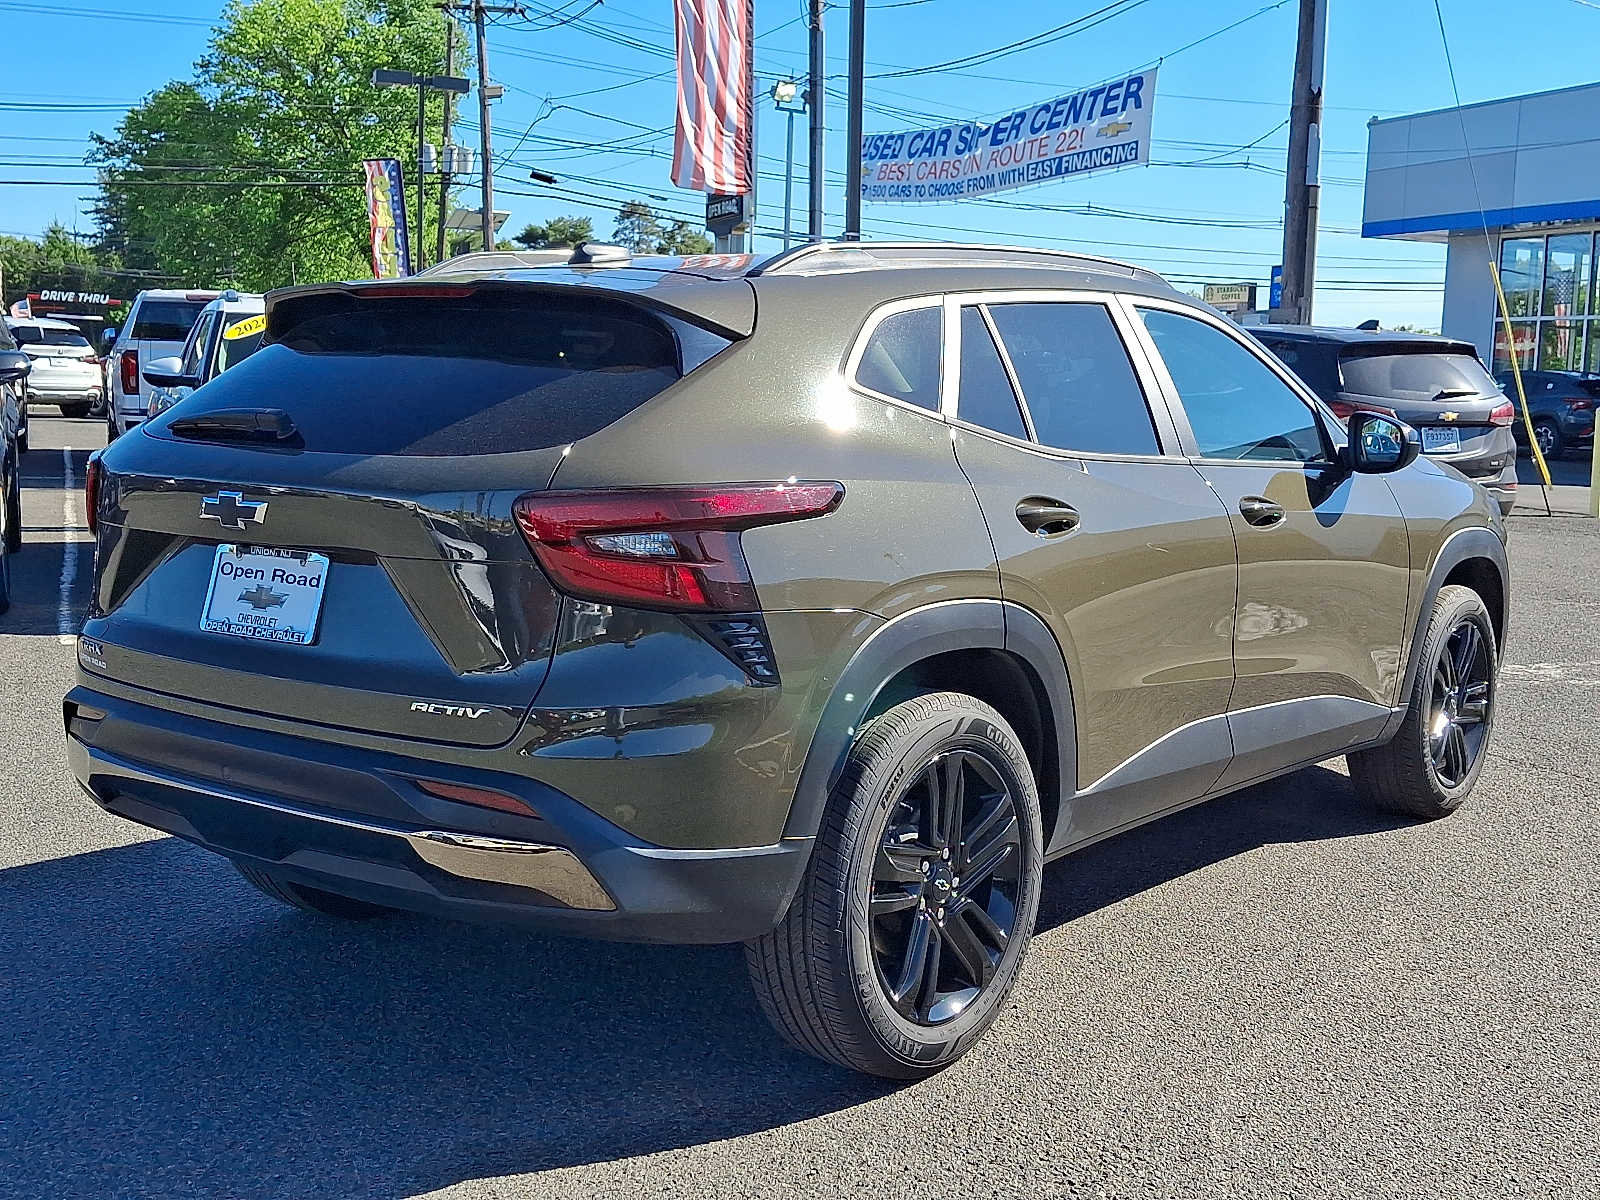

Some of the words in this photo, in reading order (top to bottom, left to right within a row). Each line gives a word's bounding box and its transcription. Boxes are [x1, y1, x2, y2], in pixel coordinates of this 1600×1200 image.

[862, 134, 905, 160] USED
[907, 128, 953, 160] CAR
[1029, 75, 1144, 135] CENTER
[877, 162, 914, 181] BEST
[916, 159, 962, 180] CARS
[986, 135, 1050, 171] ROUTE
[1055, 127, 1086, 154] 22!
[888, 183, 912, 198] CARS
[914, 184, 926, 197] TO
[927, 180, 964, 198] CHOOSE
[966, 173, 996, 193] FROM
[997, 166, 1026, 187] WITH
[1028, 158, 1059, 180] EASY
[1060, 142, 1138, 173] FINANCING
[40, 289, 75, 302] DRIVE
[78, 291, 110, 305] THRU
[279, 548, 291, 558] NJ
[220, 561, 265, 581] Open
[271, 567, 322, 588] Road
[205, 620, 229, 631] OPEN
[229, 623, 254, 637] ROAD
[255, 627, 306, 643] CHEVROLET
[237, 612, 279, 628] CHEVROLET
[410, 701, 492, 719] ACTIV
